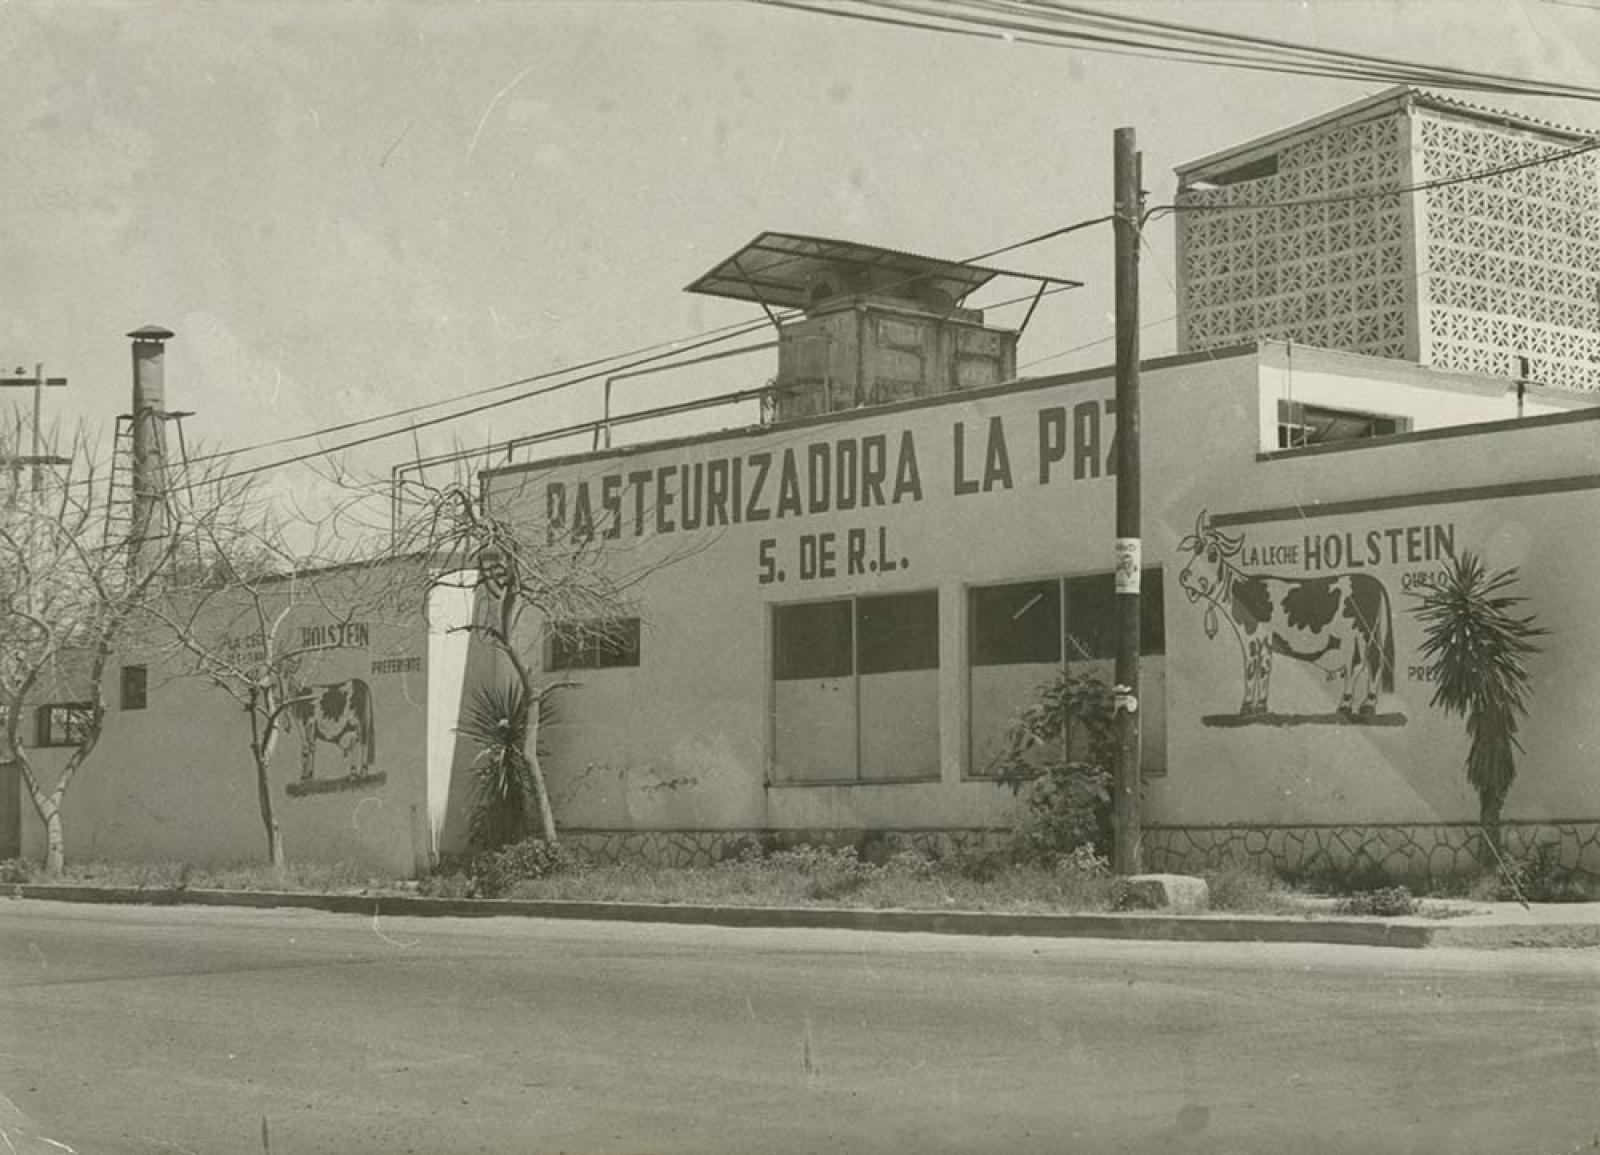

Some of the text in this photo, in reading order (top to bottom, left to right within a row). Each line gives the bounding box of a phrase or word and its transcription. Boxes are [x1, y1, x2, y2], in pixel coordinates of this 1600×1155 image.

[546, 430, 923, 547] PASTEURIZADORA
[953, 416, 1013, 496] LA
[758, 526, 910, 584] S. DE R.L.
[1241, 523, 1455, 571] LA LECHE HOLSTEIN
[301, 622, 370, 648] HOLSTEIN
